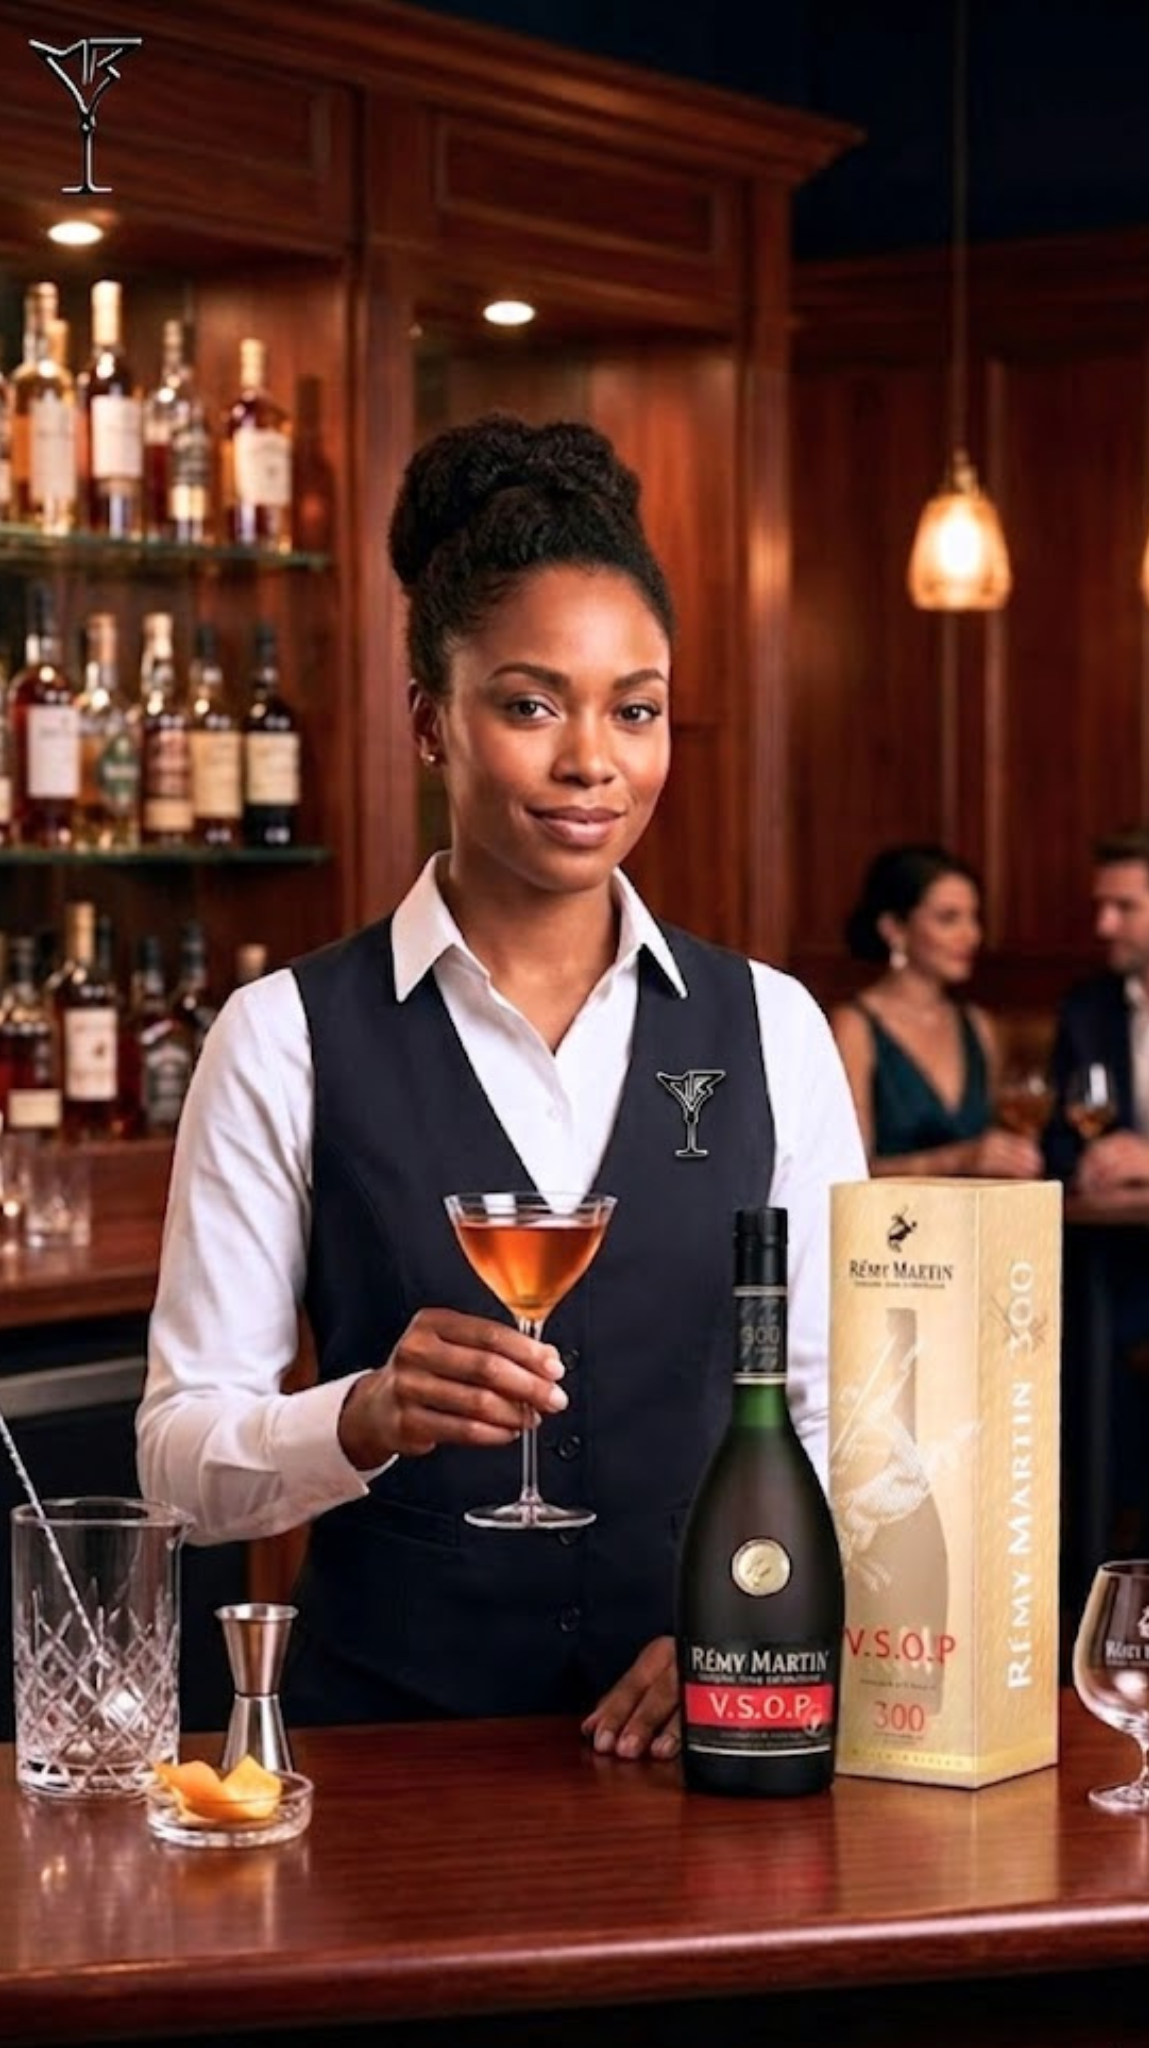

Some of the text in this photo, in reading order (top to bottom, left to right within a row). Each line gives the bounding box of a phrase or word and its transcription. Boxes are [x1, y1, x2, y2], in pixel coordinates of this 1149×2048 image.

[893, 1261, 953, 1281] MARTIN
[1008, 1382, 1033, 1556] MARTIN
[1007, 1570, 1033, 1689] RÉMY
[691, 1647, 829, 1673] RÉMY MARTIN
[873, 1700, 924, 1732] 300
